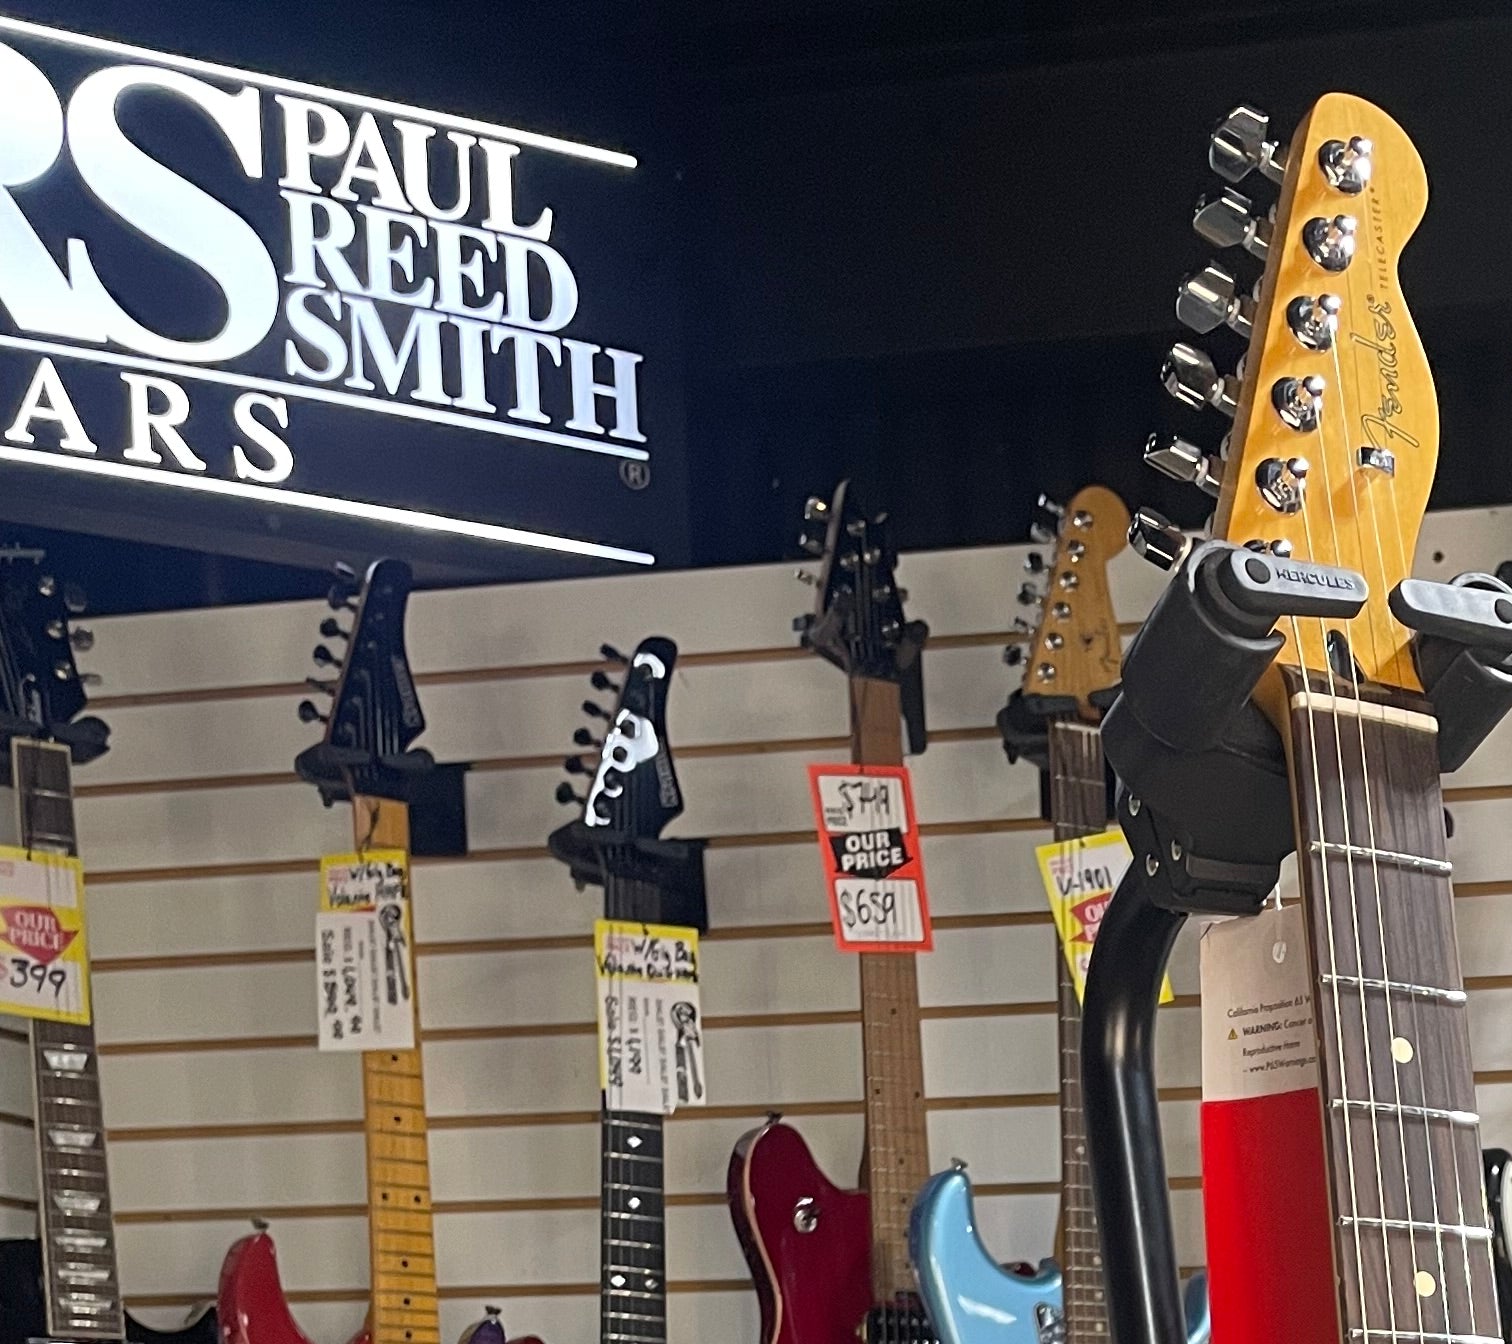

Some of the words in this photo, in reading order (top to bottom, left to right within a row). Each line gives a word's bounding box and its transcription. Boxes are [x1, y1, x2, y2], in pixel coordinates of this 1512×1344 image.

[274, 94, 553, 242] PAUL
[280, 191, 578, 333] REED
[1371, 197, 1388, 290] TELECASTER
[285, 290, 647, 443] SMITH
[1350, 300, 1419, 450] Fender
[1276, 567, 1354, 591] HERCULES
[841, 848, 904, 872] PRICE
[844, 831, 891, 850] OUR
[9, 929, 63, 950] PRICE
[14, 911, 57, 932] OUR
[10, 957, 67, 998] 399
